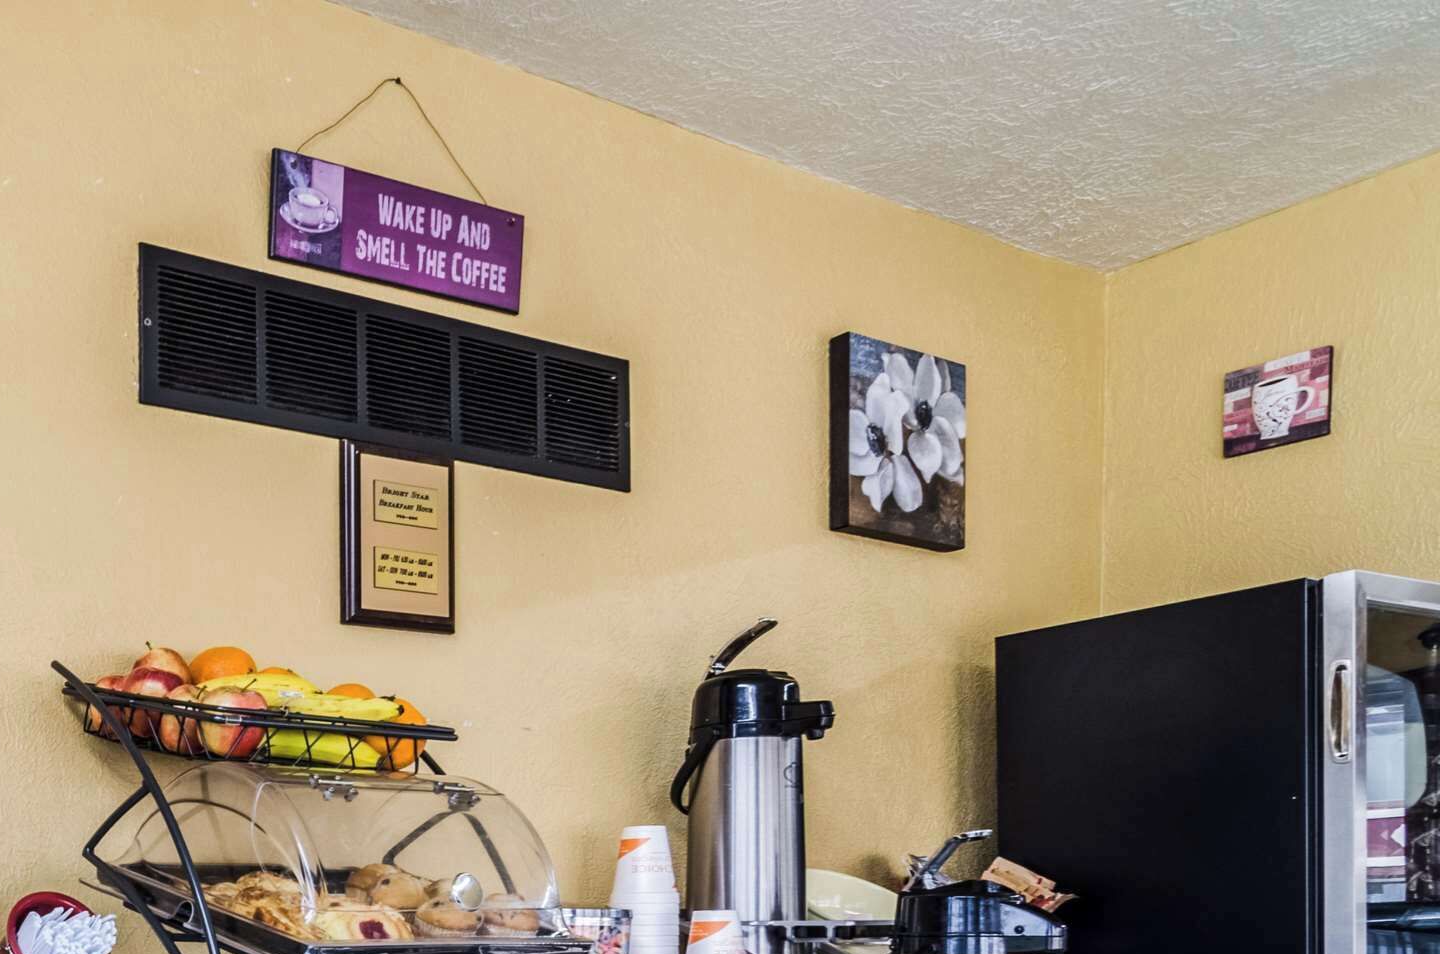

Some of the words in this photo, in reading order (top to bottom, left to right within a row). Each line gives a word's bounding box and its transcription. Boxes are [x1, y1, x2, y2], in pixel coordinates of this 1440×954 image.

[378, 193, 426, 235] WAKE
[430, 207, 453, 241] UP
[457, 215, 491, 250] AND
[355, 229, 410, 271] SMELL
[416, 244, 447, 279] THE
[451, 252, 508, 293] COFFEE
